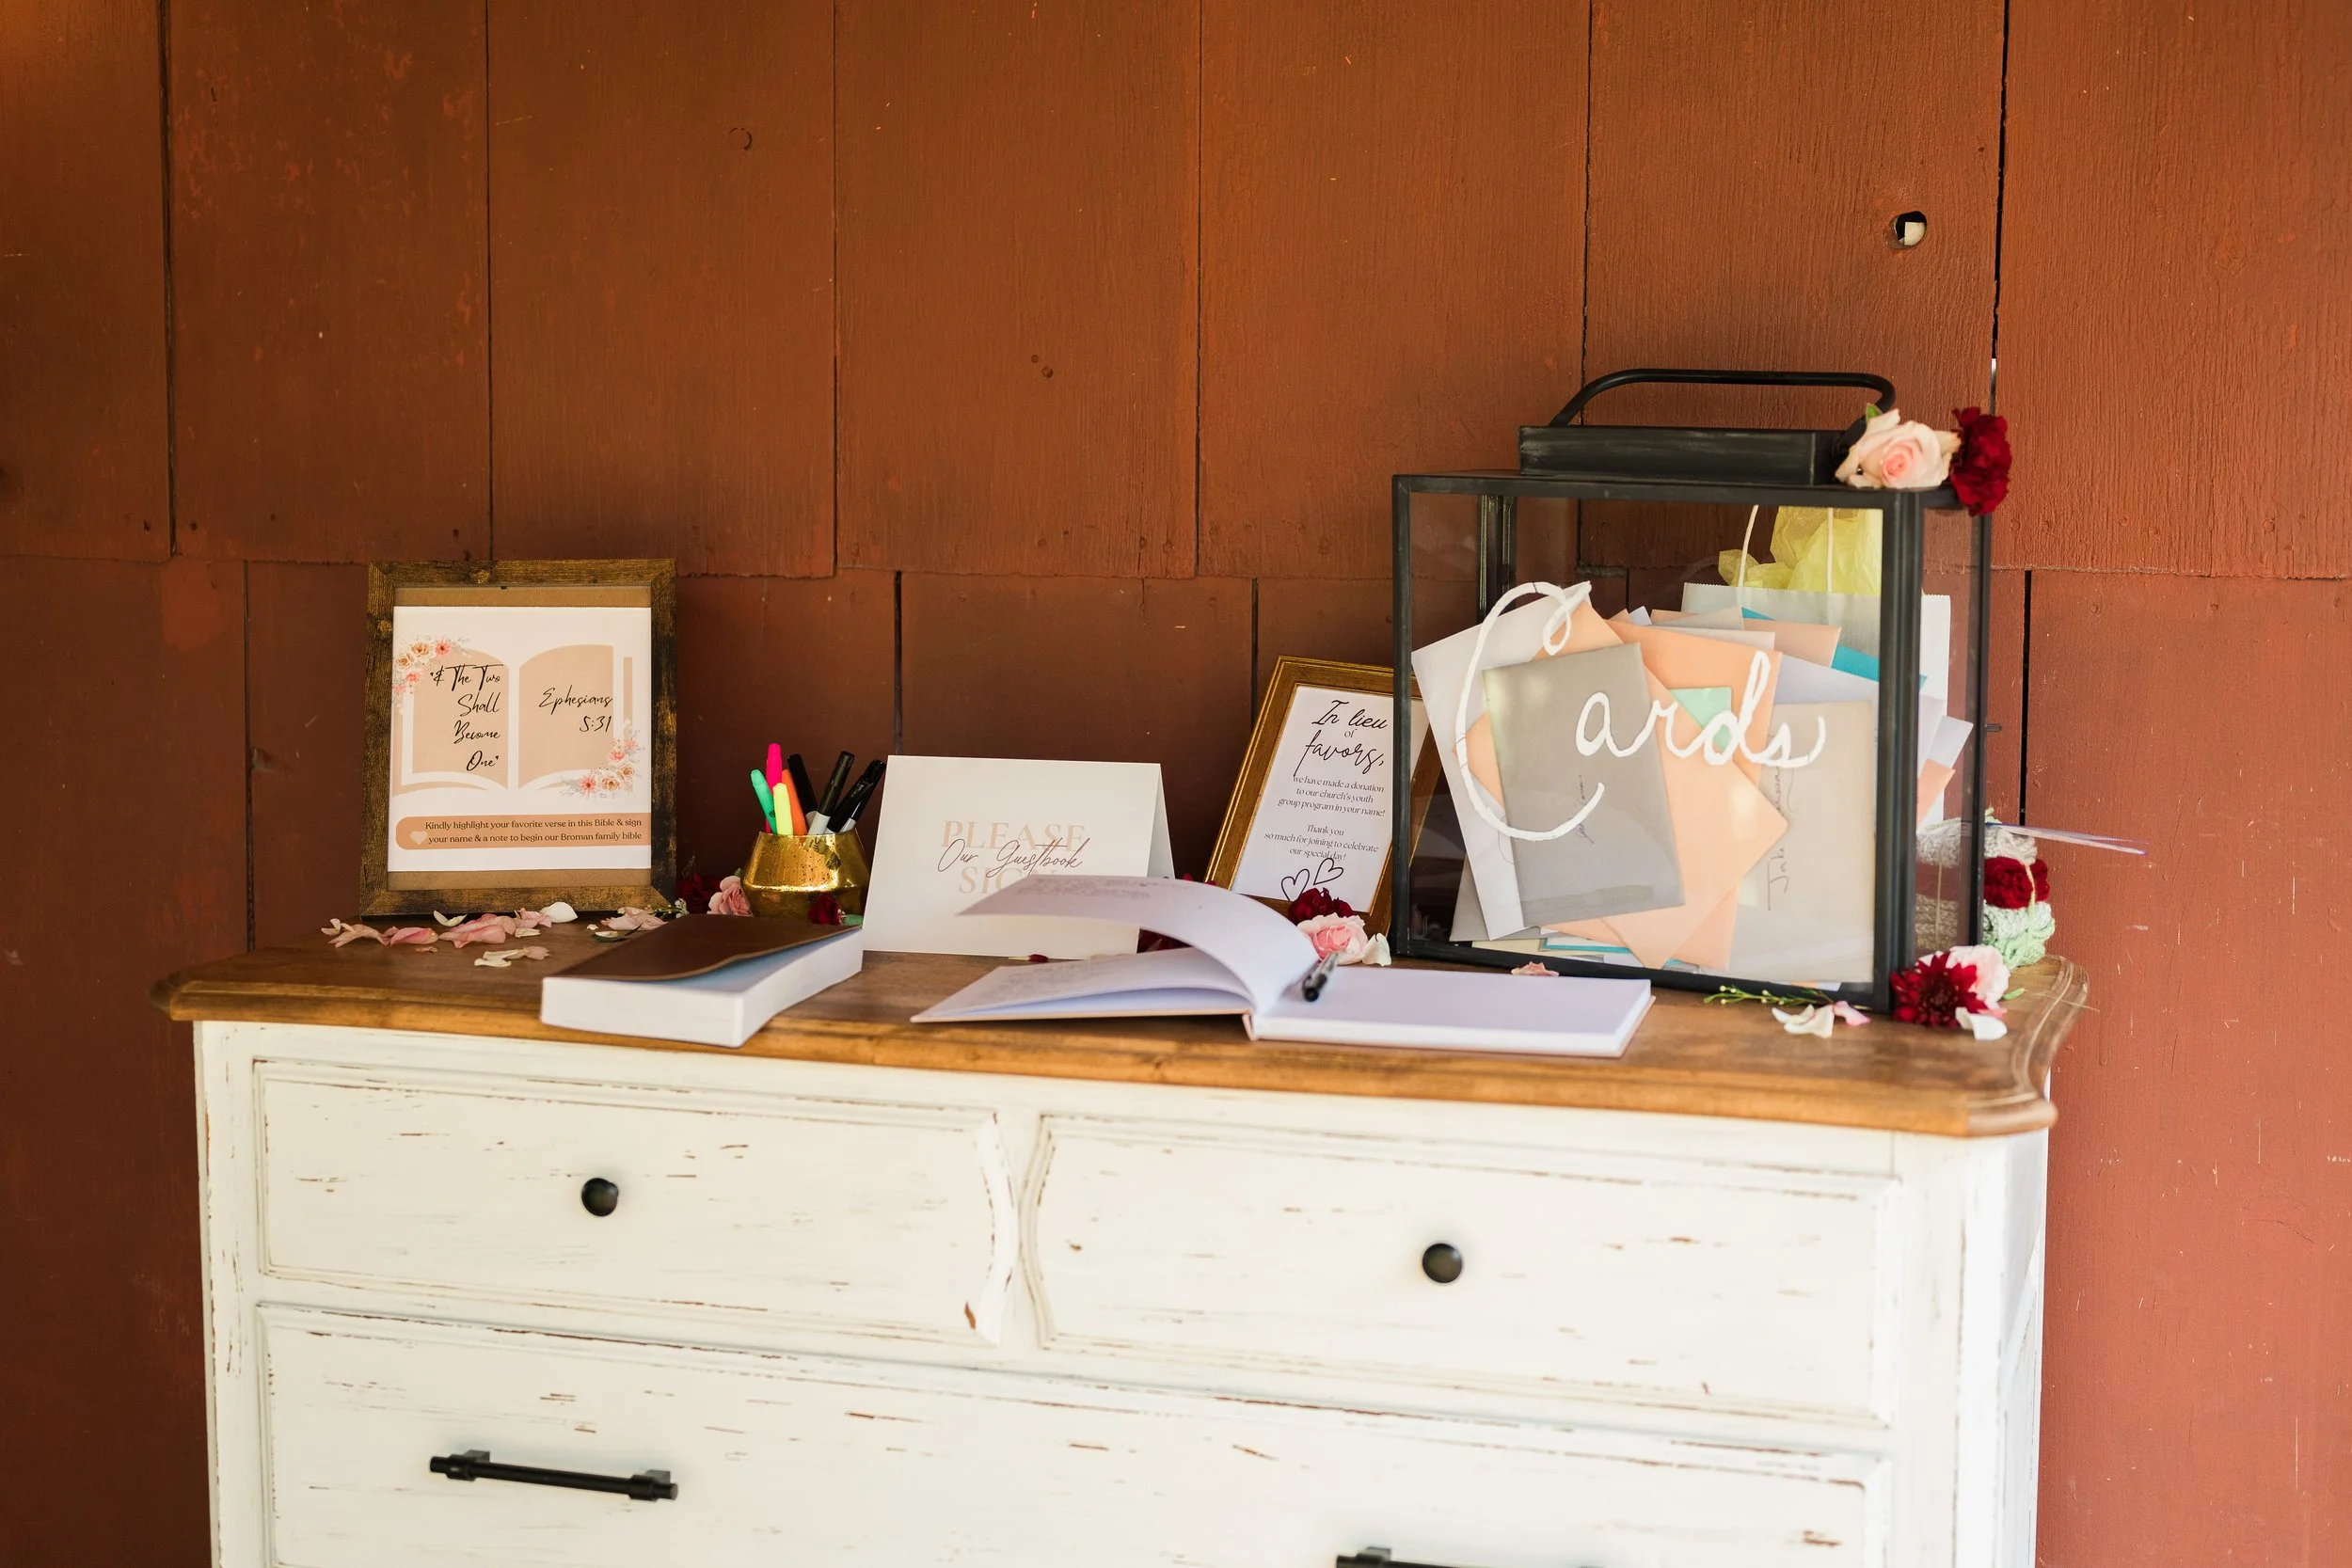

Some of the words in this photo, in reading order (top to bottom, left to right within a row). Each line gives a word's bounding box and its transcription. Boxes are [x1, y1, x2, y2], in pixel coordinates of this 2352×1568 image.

[445, 664, 476, 691] The
[472, 664, 503, 691] Two
[457, 691, 501, 717] Shall
[539, 684, 613, 715] Ephesians
[1311, 699, 1349, 725] In
[1348, 708, 1388, 729] lieu
[1456, 579, 1827, 841] Cards
[453, 720, 501, 744] Become
[579, 715, 612, 732] 5:31
[1343, 728, 1358, 738] of
[1293, 729, 1384, 777] favors,
[1304, 775, 1322, 785] have
[1322, 779, 1343, 788] made
[1351, 781, 1385, 793] donation
[1319, 790, 1351, 801] church's
[1350, 794, 1374, 803] youth
[1278, 797, 1301, 809] group
[1300, 800, 1336, 811] program
[1342, 805, 1361, 814] your
[1361, 808, 1386, 817] name!
[425, 821, 452, 831] Kindly
[453, 820, 488, 830] highlight
[488, 821, 510, 830] your
[511, 820, 543, 829] favorite
[567, 819, 576, 828] in
[595, 818, 614, 827] Bible
[616, 818, 624, 827] &
[625, 818, 642, 827] sign
[1306, 824, 1328, 833] Thank
[1328, 828, 1344, 836] you
[520, 833, 543, 843] begin
[561, 832, 594, 841] Broman
[595, 832, 621, 841] family
[622, 832, 642, 840] bible
[941, 819, 1086, 853] PLEASE
[1274, 832, 1295, 842] much
[1295, 834, 1308, 843] for
[1306, 836, 1334, 847] joining
[1343, 841, 1379, 852] celebrate
[937, 838, 979, 873] Our
[985, 837, 1090, 878] Guestbook
[1303, 848, 1330, 859] special
[1330, 851, 1347, 862] day!
